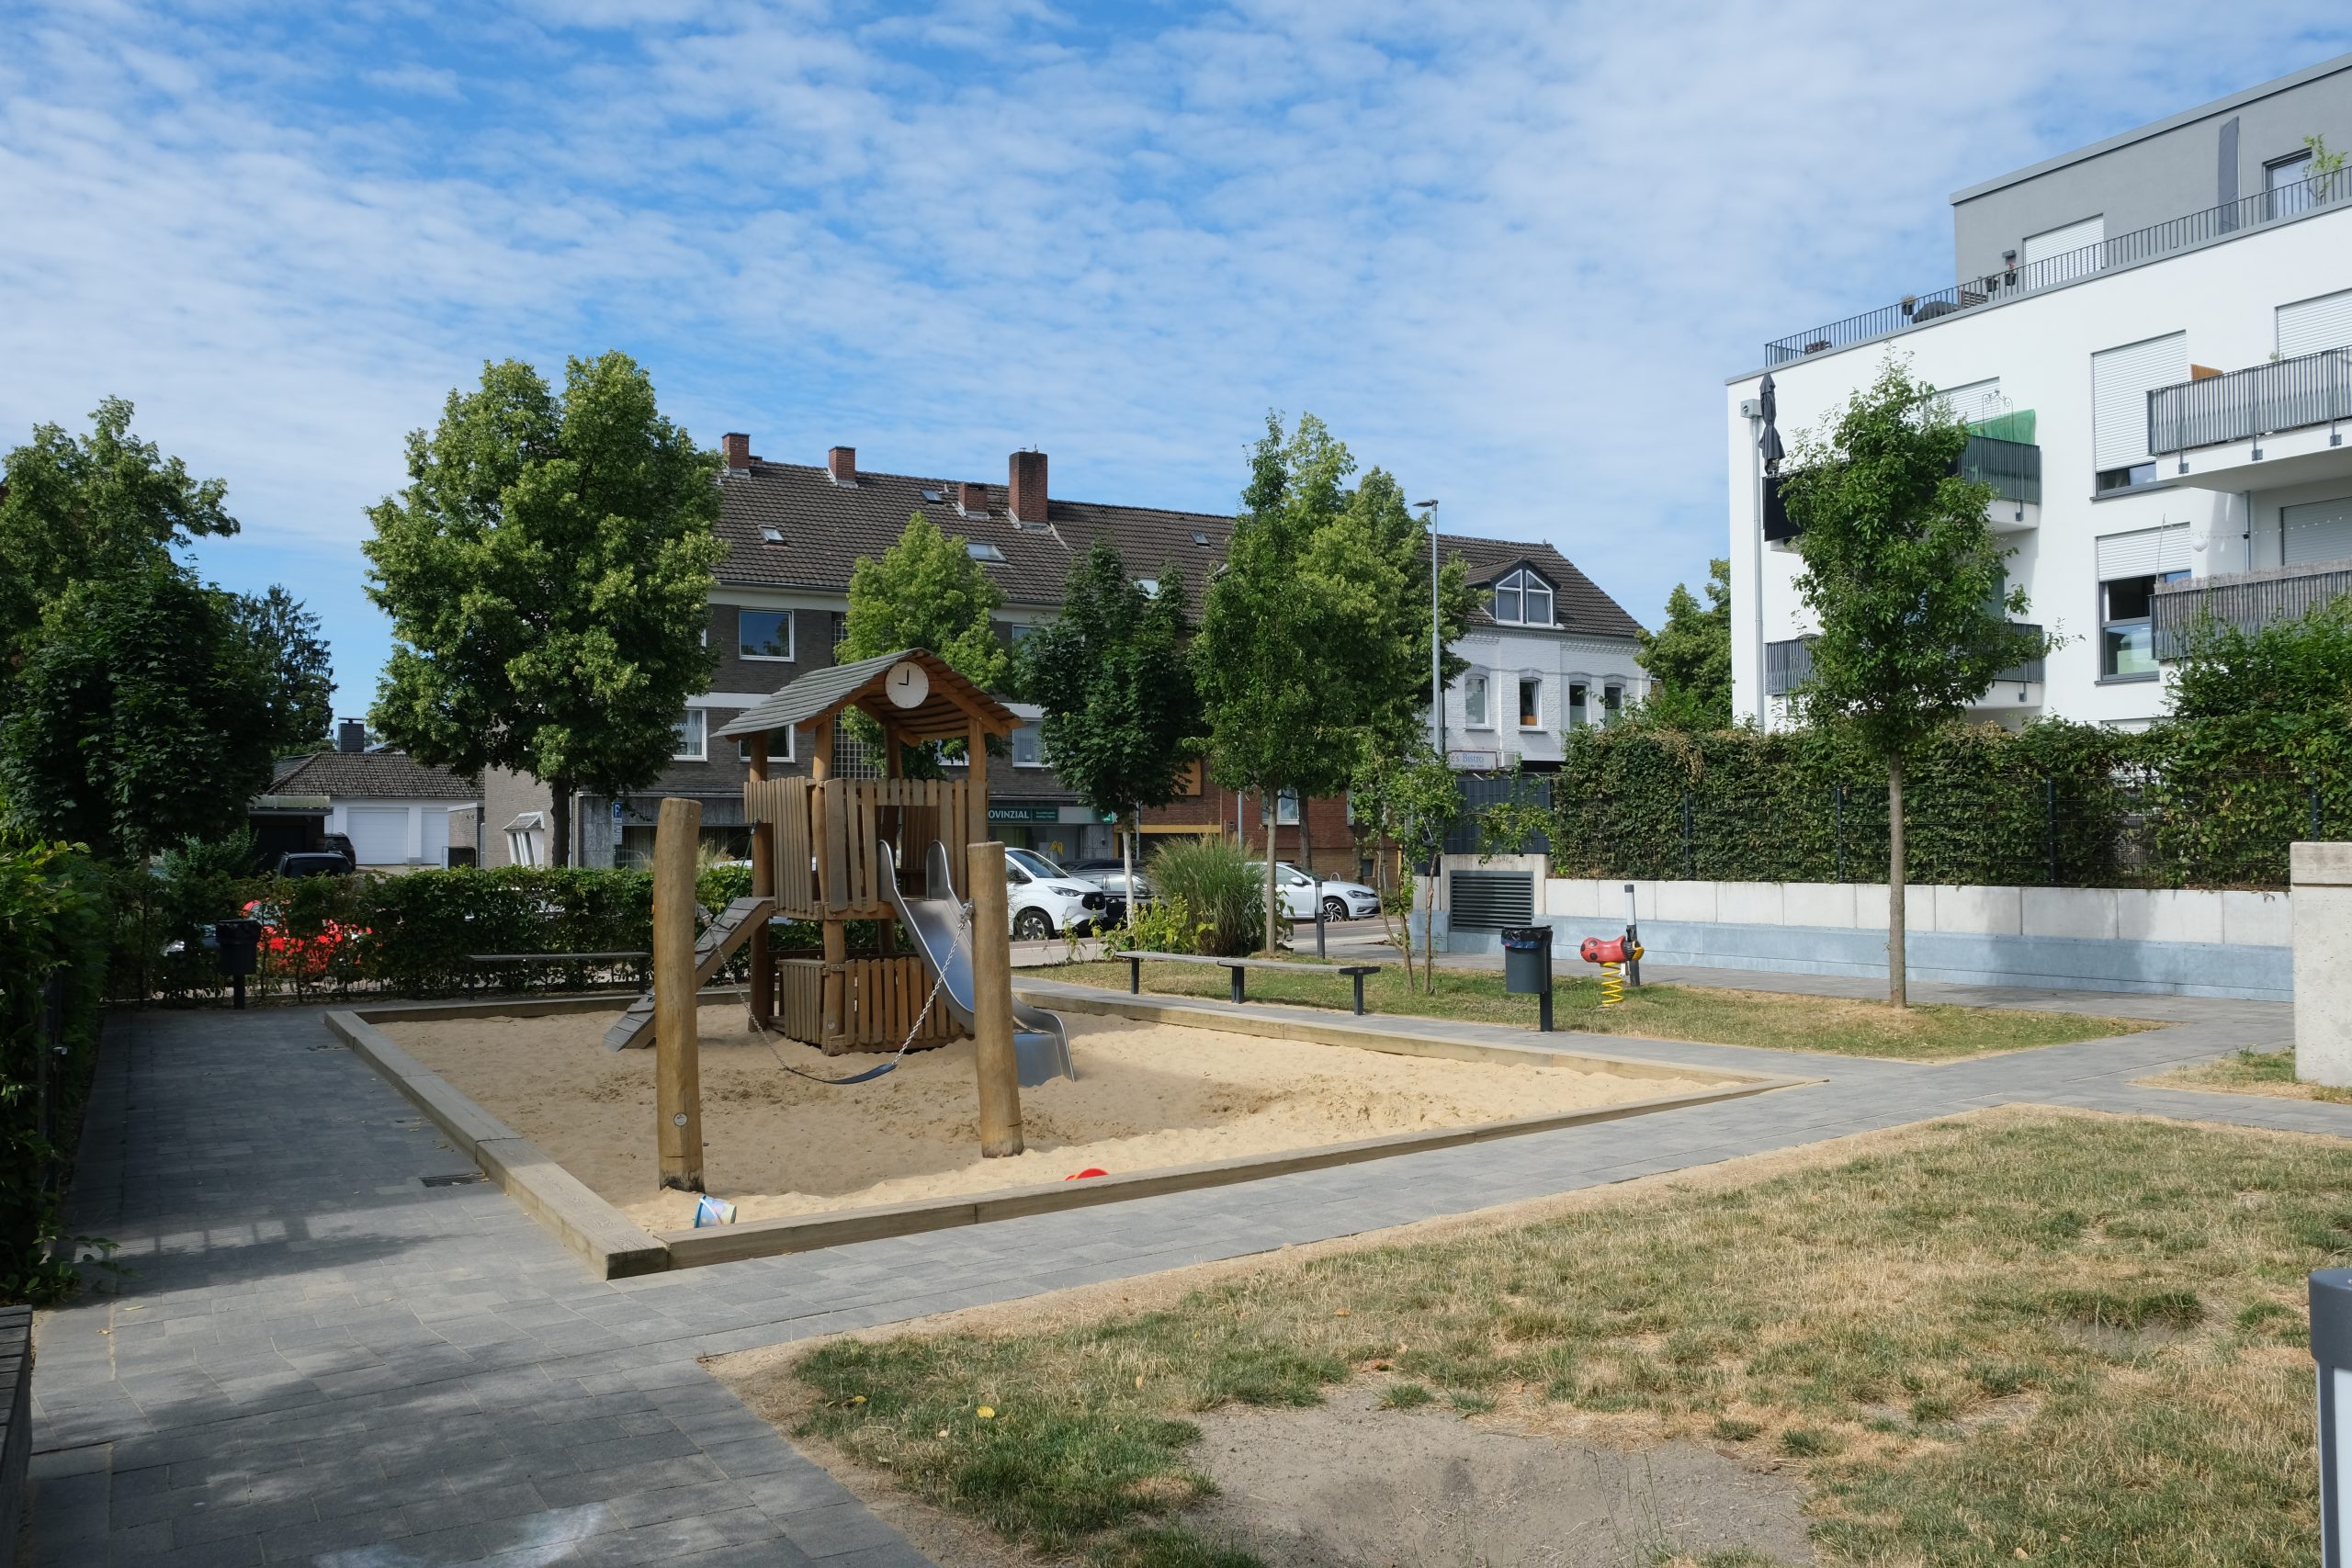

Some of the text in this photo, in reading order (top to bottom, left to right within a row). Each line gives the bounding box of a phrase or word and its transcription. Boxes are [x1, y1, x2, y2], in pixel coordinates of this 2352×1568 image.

[1463, 752, 1484, 763] Bistro
[615, 804, 620, 817] P
[988, 809, 1030, 819] OVINZIAL
